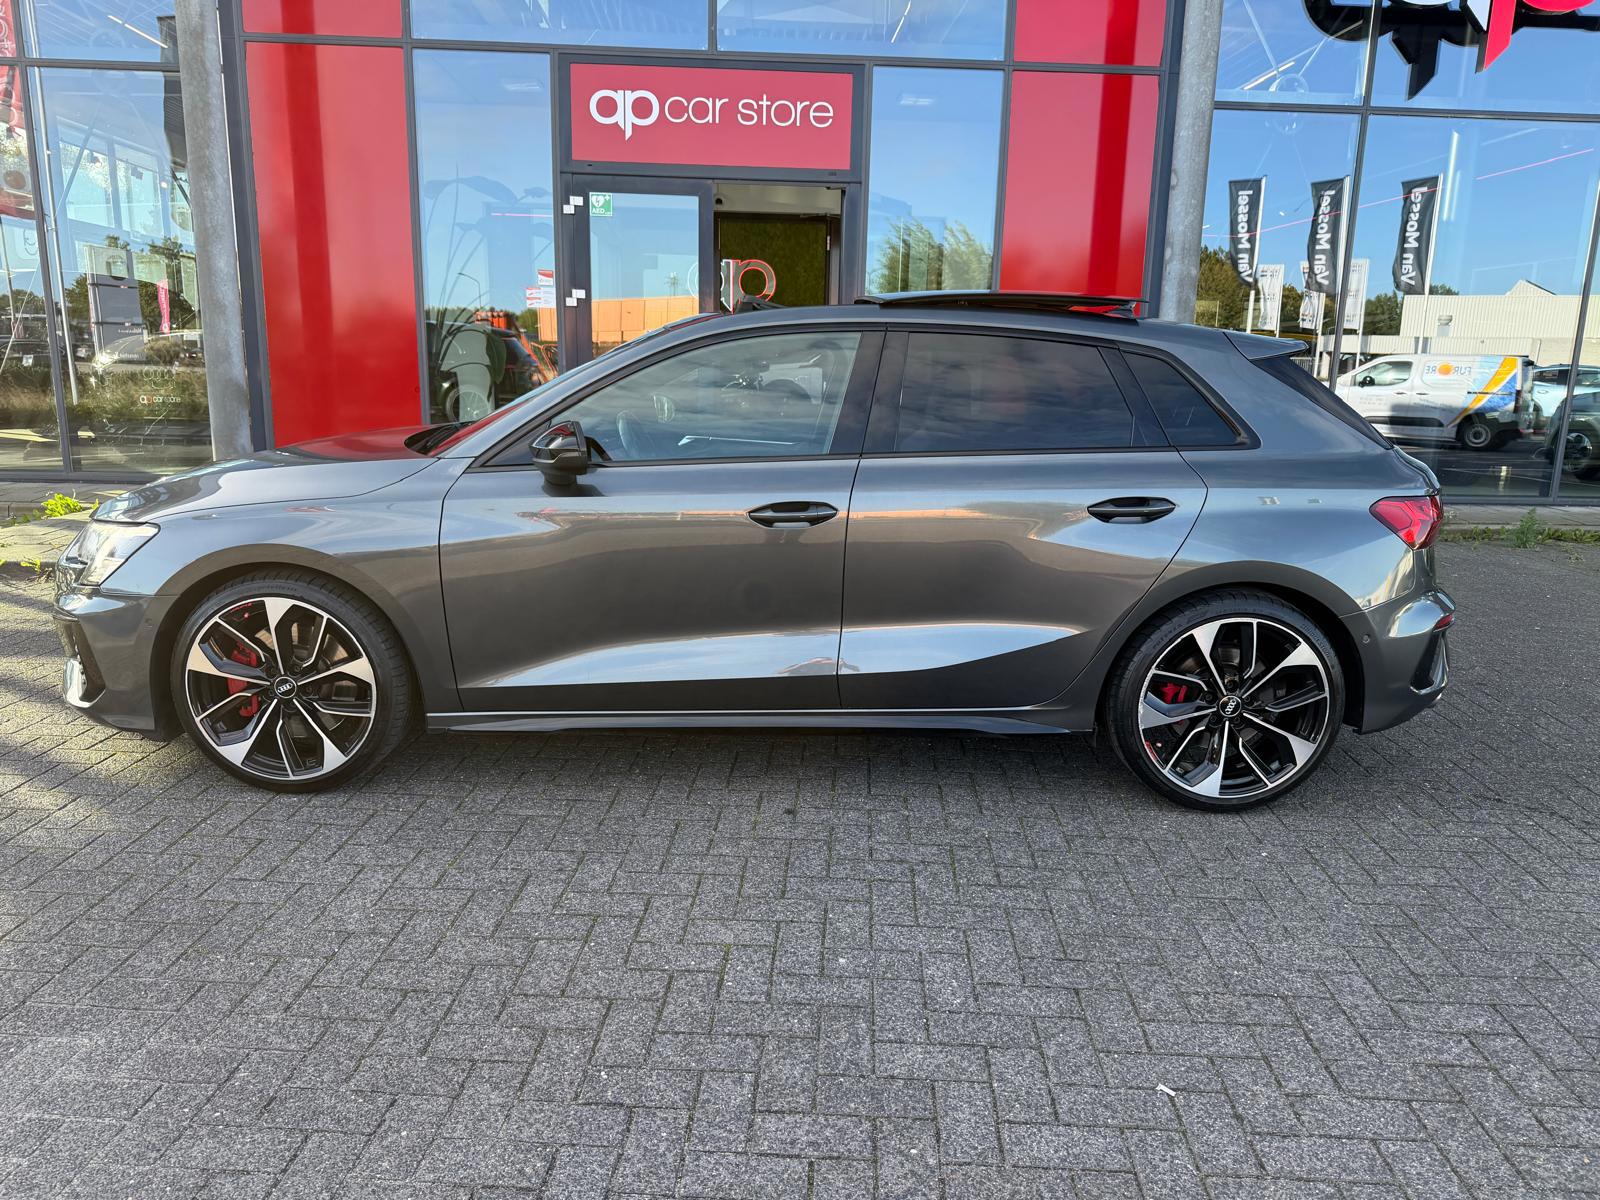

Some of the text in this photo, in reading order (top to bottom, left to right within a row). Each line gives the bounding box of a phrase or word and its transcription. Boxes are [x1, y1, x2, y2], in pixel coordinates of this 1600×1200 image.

[589, 89, 834, 141] ap car store
[591, 206, 605, 214] AED
